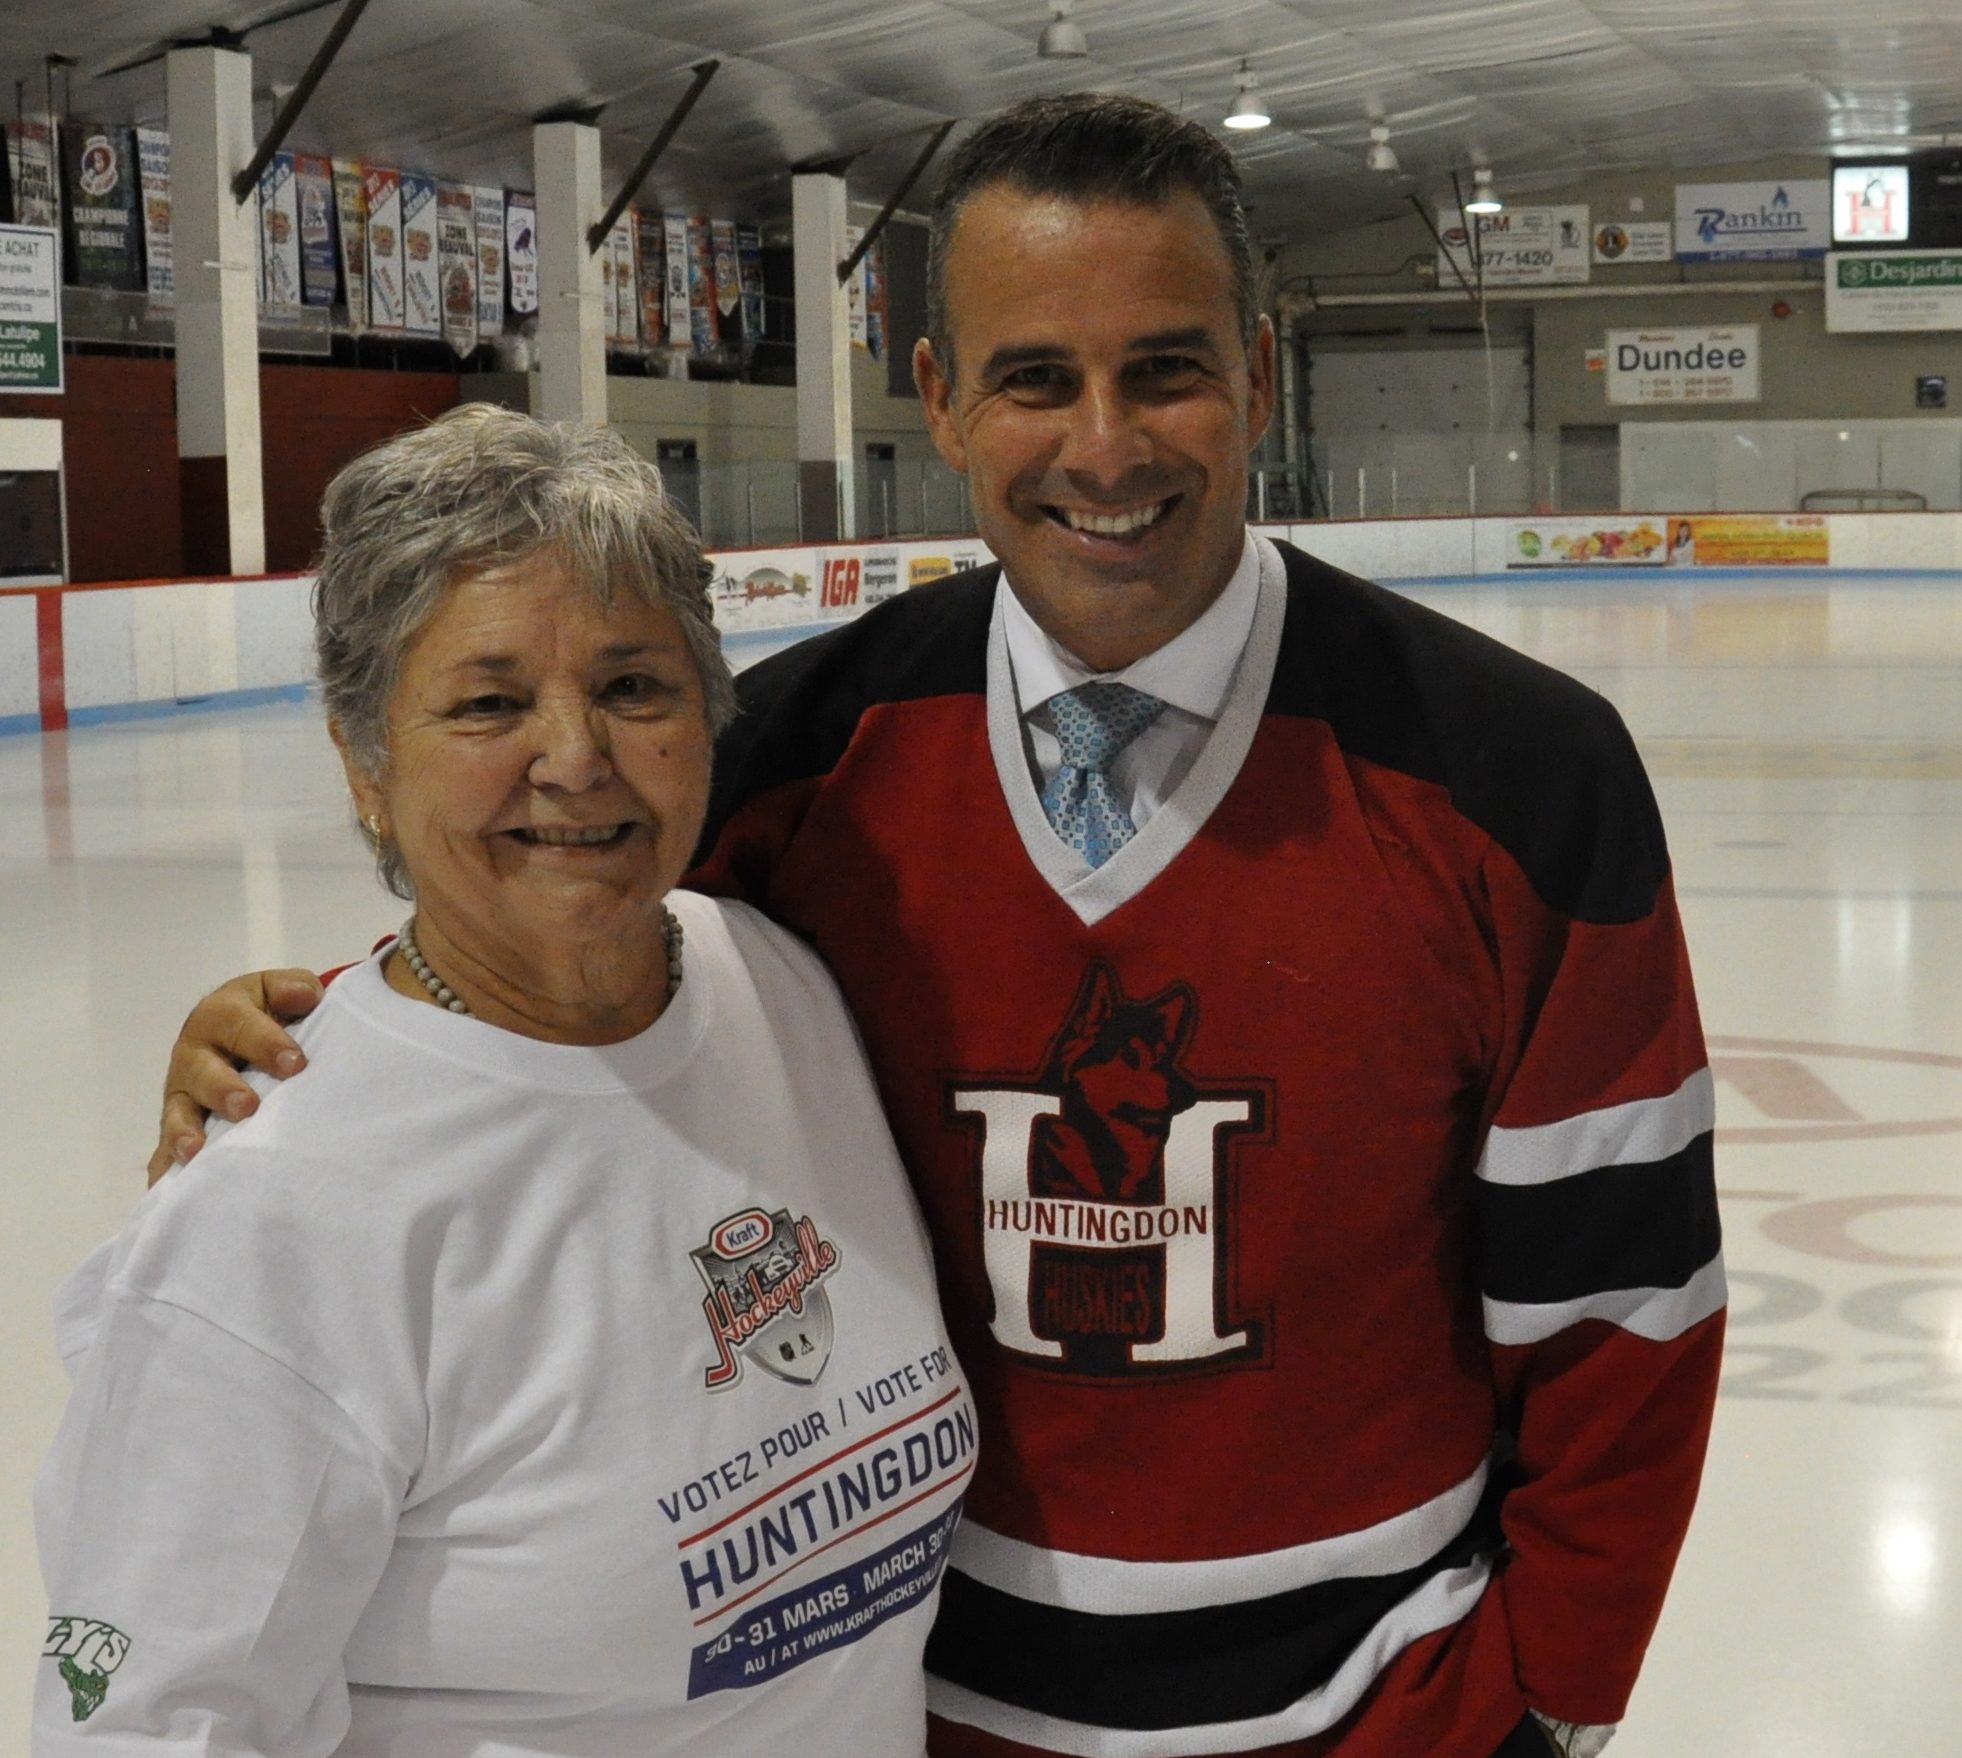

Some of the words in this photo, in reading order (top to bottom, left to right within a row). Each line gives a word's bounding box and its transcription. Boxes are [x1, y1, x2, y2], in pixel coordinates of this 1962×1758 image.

[1478, 215, 1510, 233] GM
[1694, 205, 1803, 238] Rankin
[6, 240, 40, 257] ACHAT
[1617, 342, 1747, 371] Dundee
[820, 557, 861, 609] IGA
[726, 1222, 761, 1248] Kraft
[988, 1199, 1208, 1243] HUNTINGDON
[702, 1216, 836, 1387] Hockeyville
[657, 1450, 760, 1524] VOTEZ
[760, 1410, 831, 1469] POUR
[837, 1397, 849, 1428] /
[855, 1364, 923, 1415] VOTE
[919, 1344, 954, 1383] FOR
[680, 1401, 976, 1611] HUNTINGDON
[781, 1583, 850, 1631] MARS
[862, 1539, 926, 1595] MARCH
[743, 1659, 767, 1676] AU
[780, 1640, 799, 1661] AT
